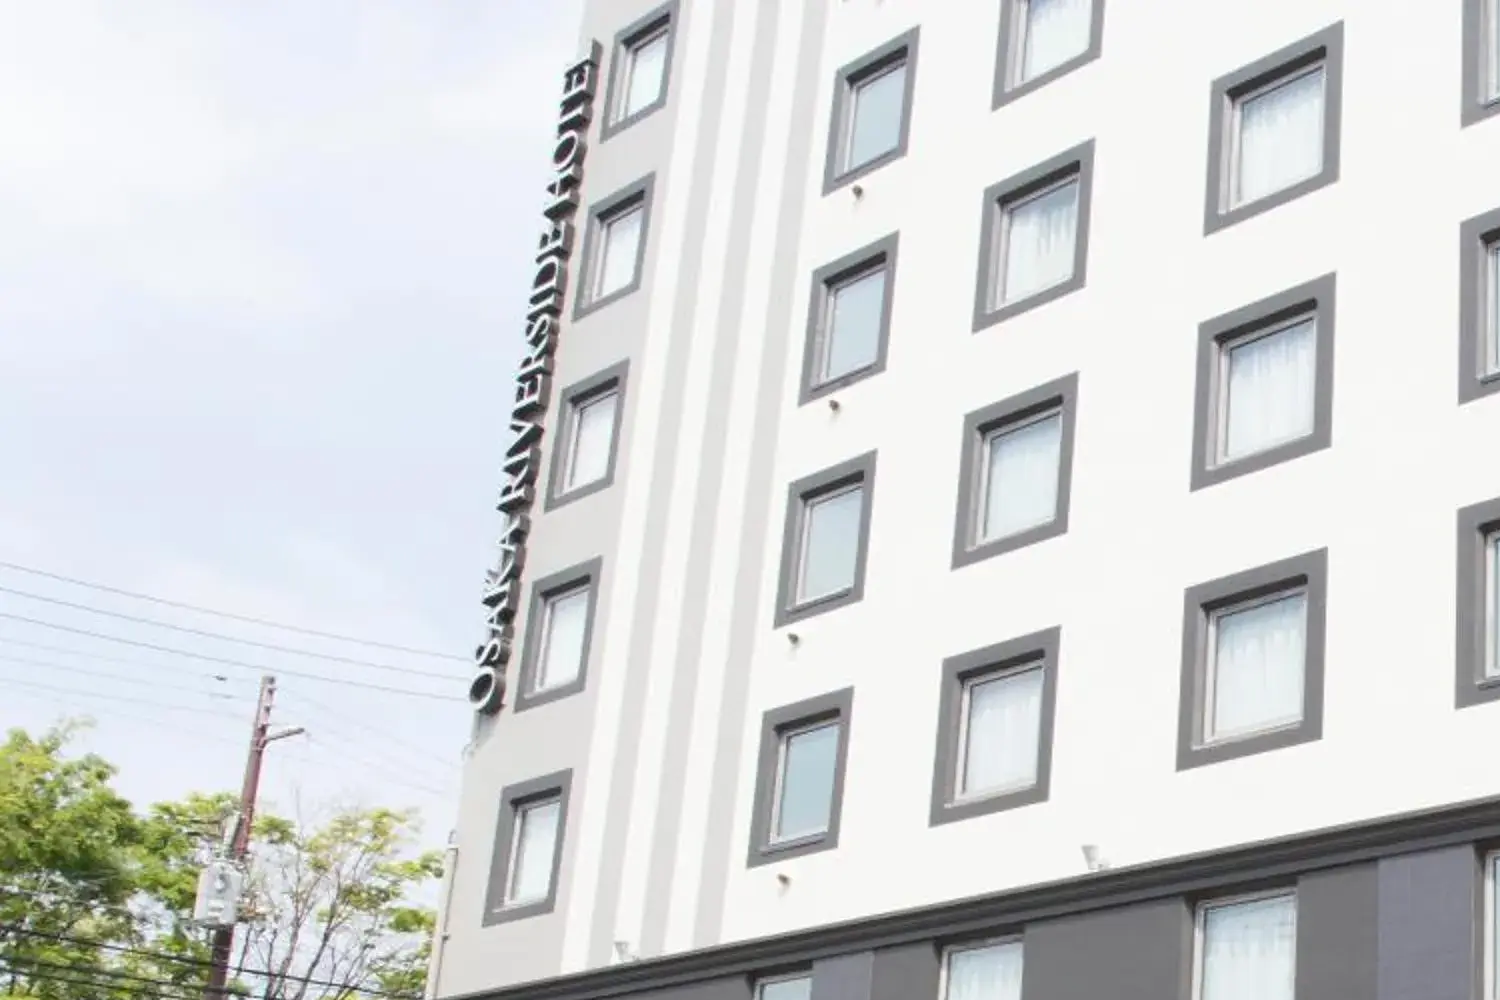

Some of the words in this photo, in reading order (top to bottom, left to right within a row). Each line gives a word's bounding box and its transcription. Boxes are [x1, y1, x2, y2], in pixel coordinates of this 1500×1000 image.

[544, 38, 602, 214] HOTEL
[497, 220, 573, 511] RIVERSIDE
[469, 514, 529, 712] OSAKA
